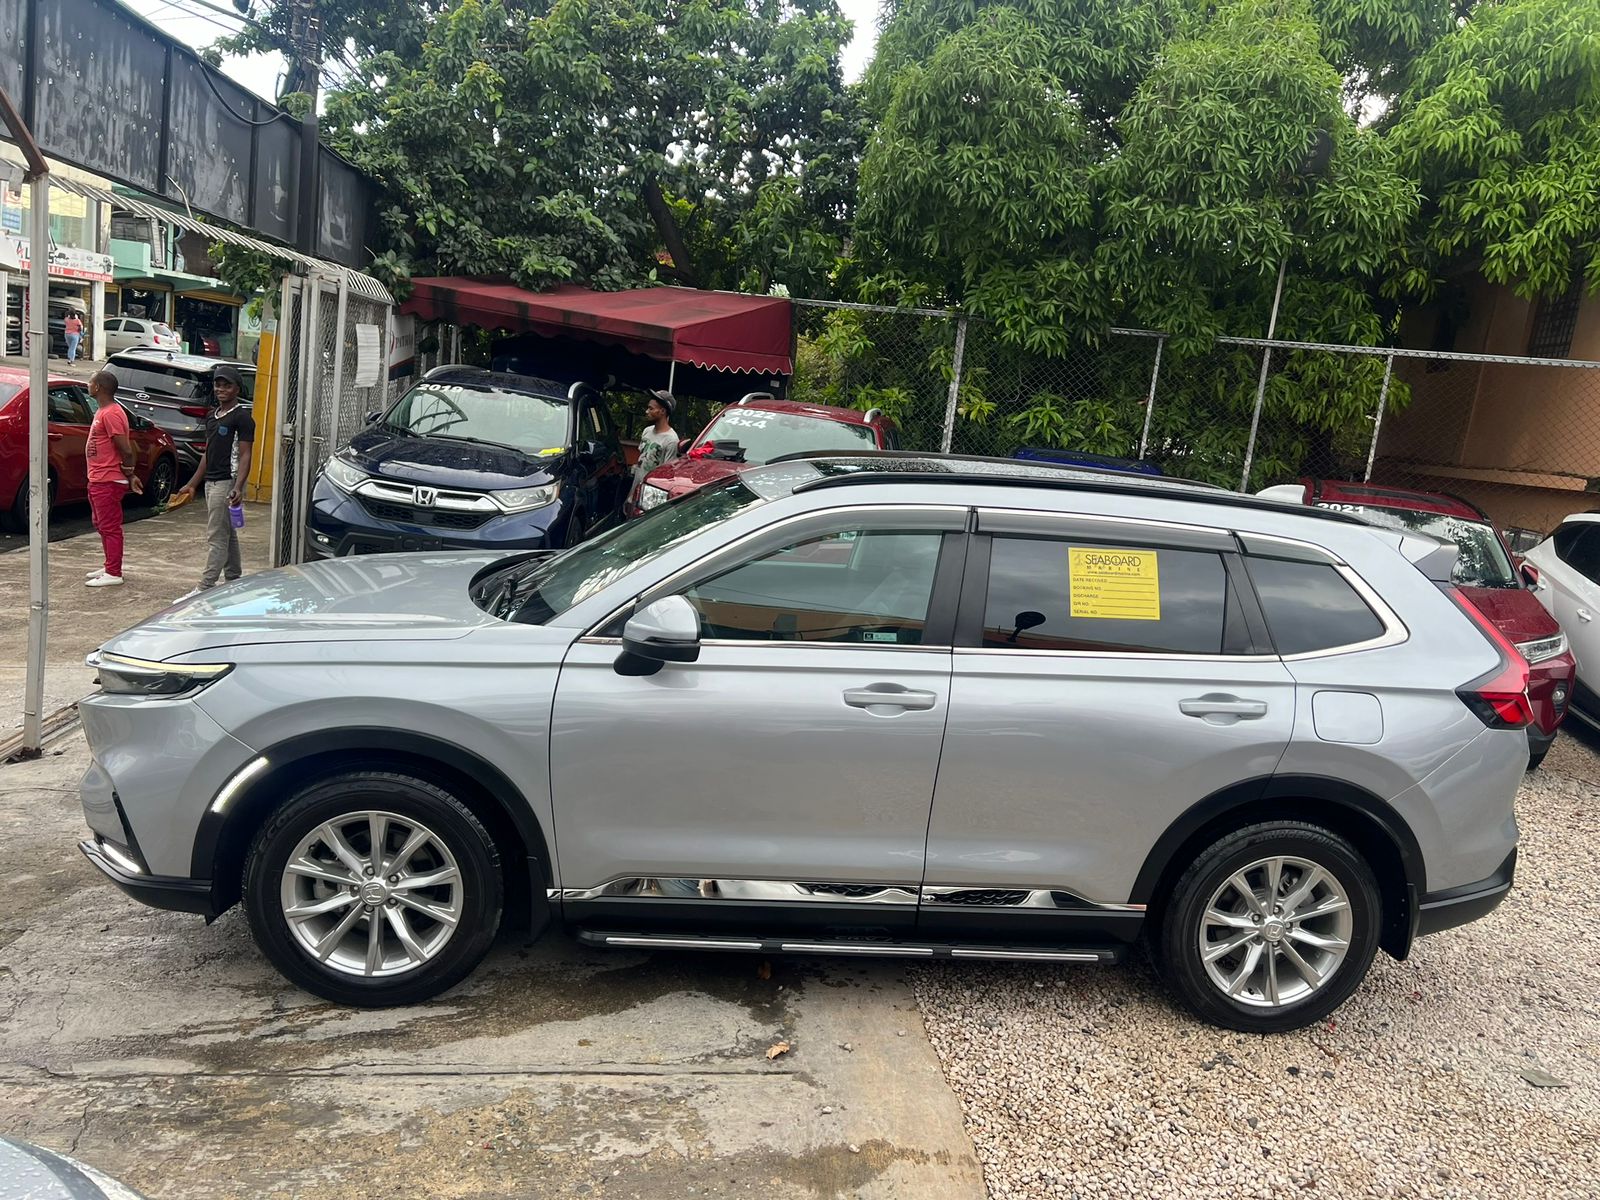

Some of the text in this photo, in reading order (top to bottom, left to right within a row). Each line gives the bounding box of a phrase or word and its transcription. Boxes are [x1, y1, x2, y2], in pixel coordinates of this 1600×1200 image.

[729, 408, 776, 420] 2022
[1317, 502, 1364, 514] 2021
[1085, 554, 1141, 567] SEABOARD
